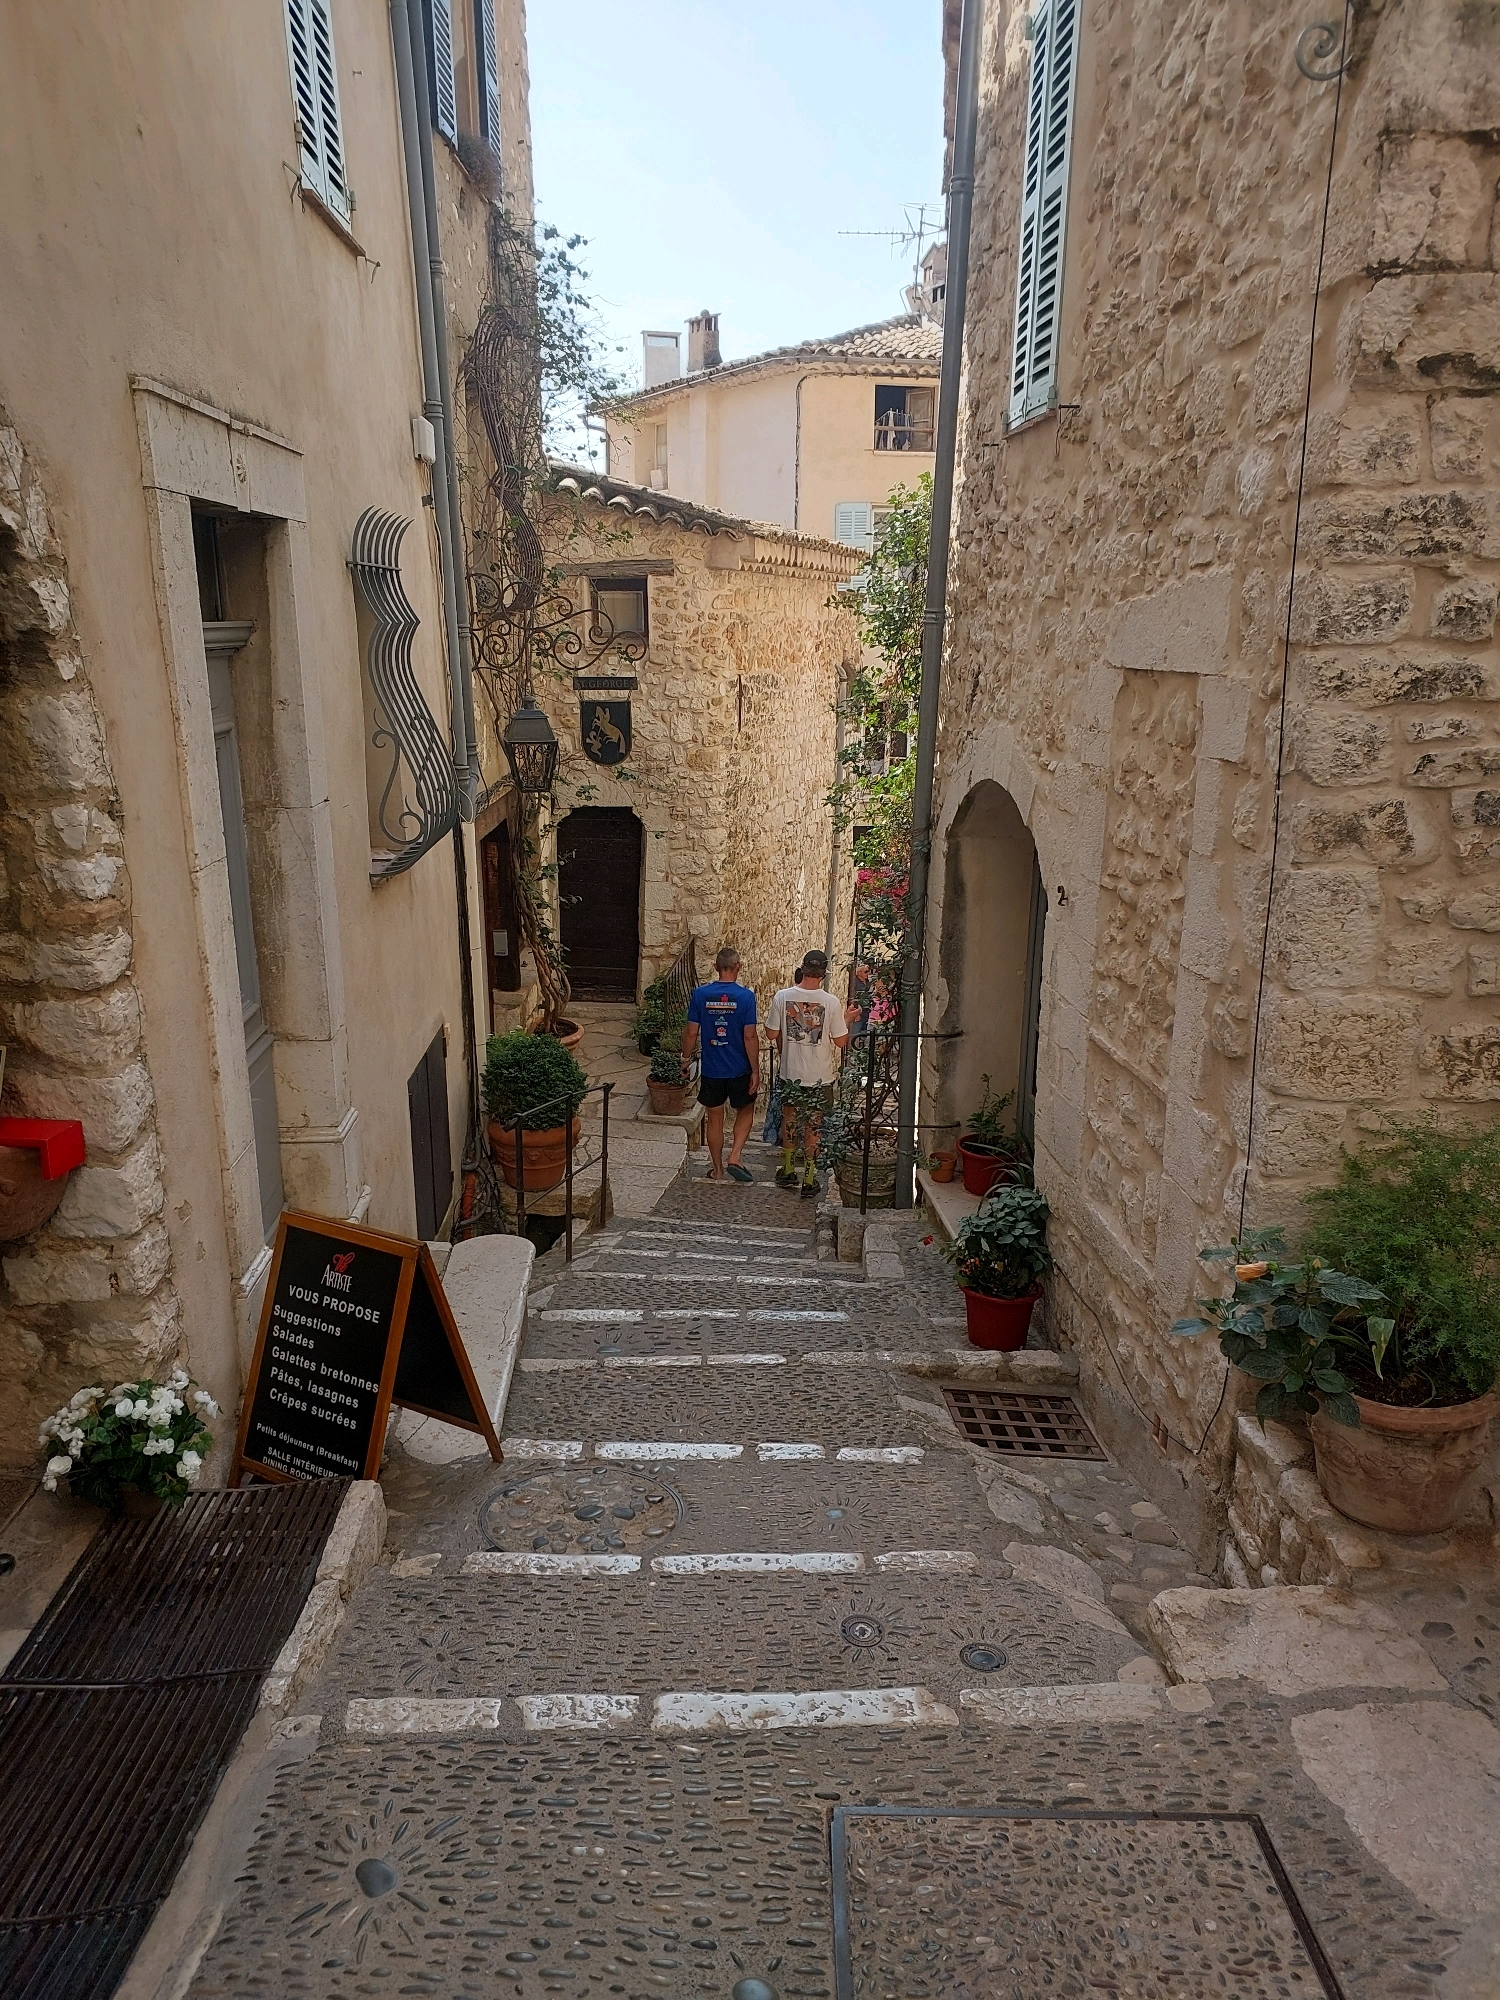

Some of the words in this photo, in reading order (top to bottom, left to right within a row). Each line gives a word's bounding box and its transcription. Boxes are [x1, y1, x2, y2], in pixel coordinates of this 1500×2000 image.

[589, 680, 634, 688] GEORGES
[1057, 885, 1068, 906] 2
[273, 1304, 341, 1337] Suggestions
[289, 1284, 320, 1304] VOUS
[322, 1296, 381, 1324] PROPOSE
[272, 1325, 315, 1349] Salades
[272, 1346, 316, 1371] Galettes
[320, 1362, 379, 1392] bretonnes
[270, 1367, 303, 1391] Pâtes,
[307, 1380, 359, 1409] lasagnes
[269, 1388, 307, 1412] Crêpes
[311, 1405, 356, 1429] sucrées
[256, 1422, 277, 1437] Petits
[278, 1431, 314, 1452] déjeuners
[316, 1446, 359, 1471] (Breakfast)
[267, 1446, 291, 1463] SALLE
[262, 1456, 288, 1473] DINING
